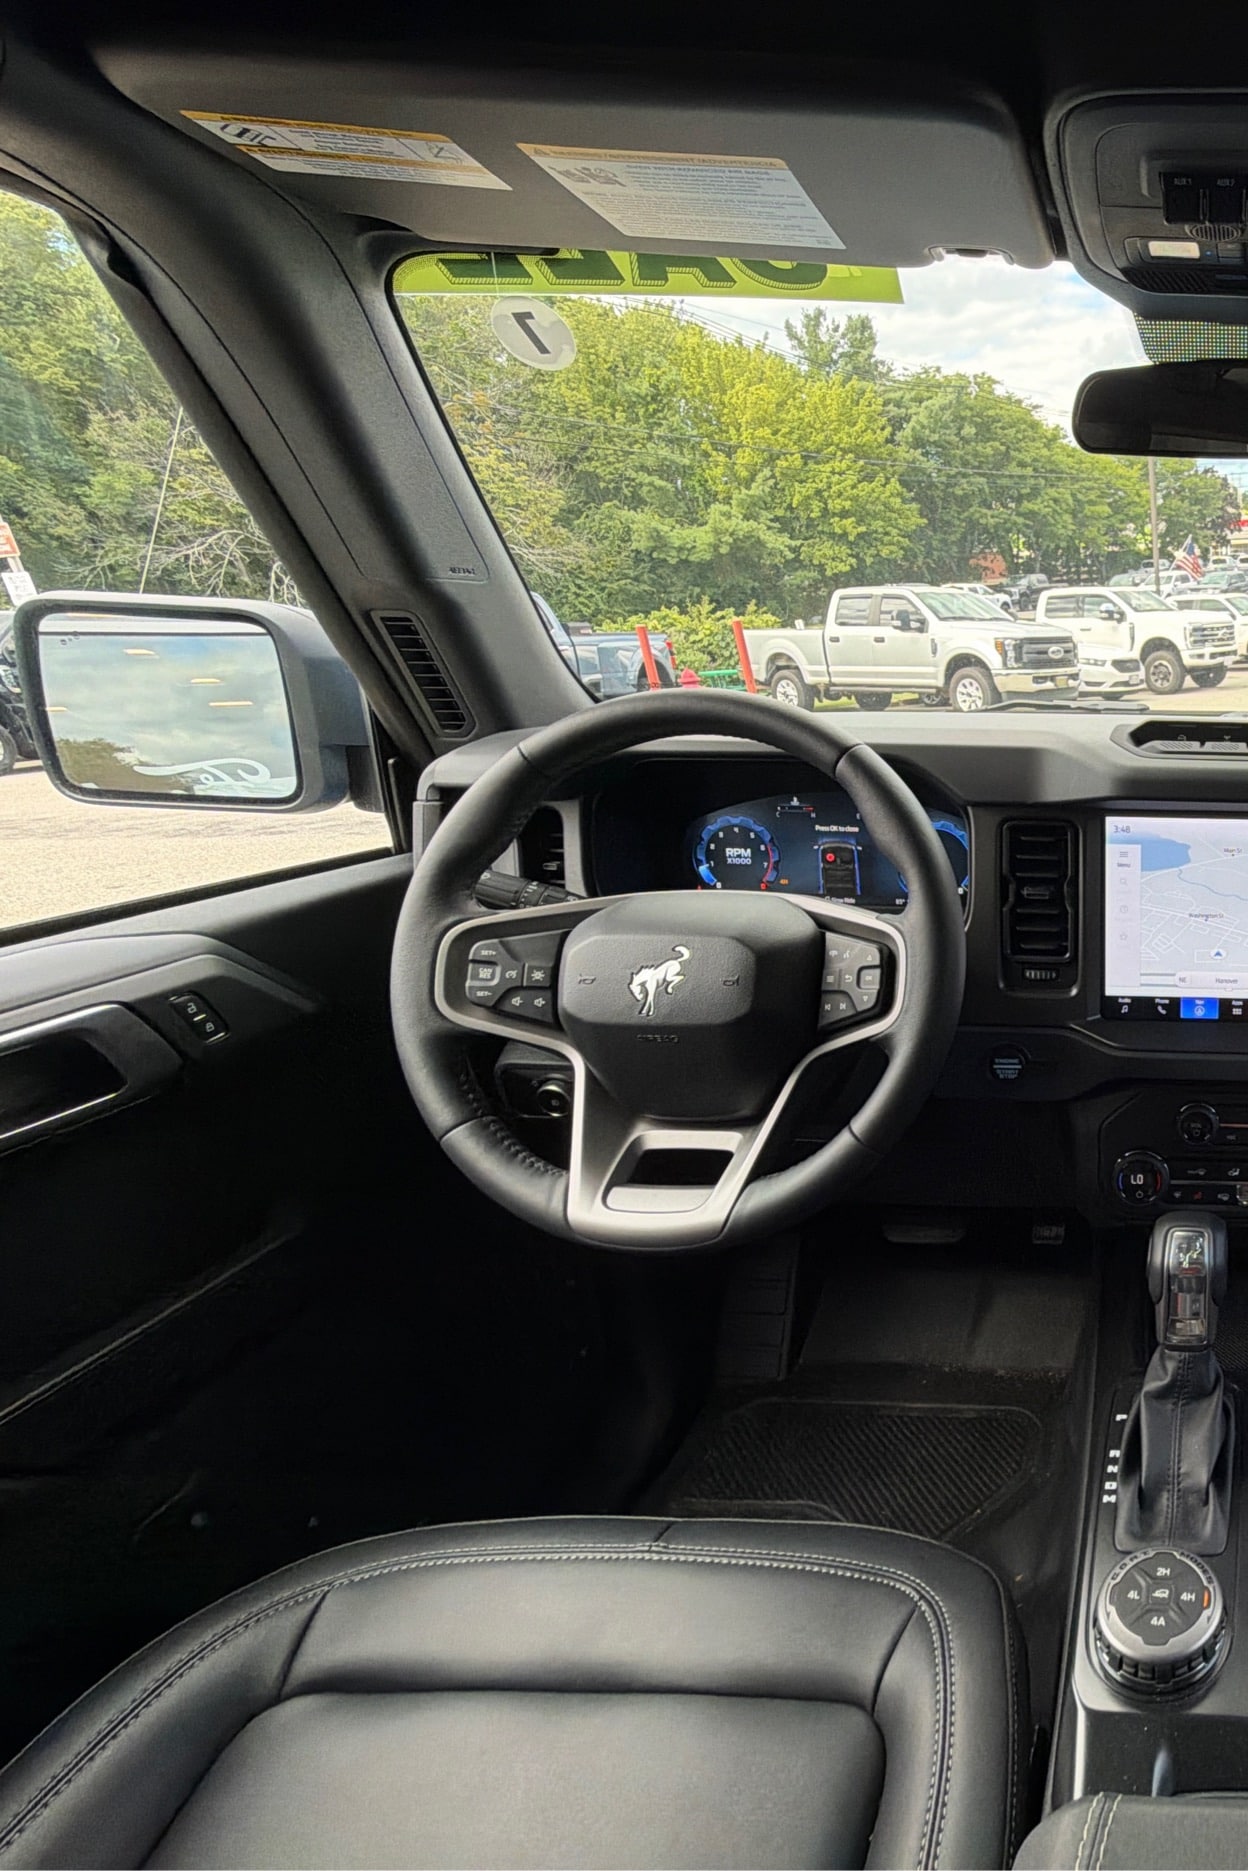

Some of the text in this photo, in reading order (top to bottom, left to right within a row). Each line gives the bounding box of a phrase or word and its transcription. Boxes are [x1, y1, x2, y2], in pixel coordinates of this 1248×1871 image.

[1113, 825, 1131, 833] 3:48
[725, 848, 751, 857] RPM
[1130, 1174, 1144, 1185] LO
[1107, 1465, 1118, 1473] N
[1102, 1495, 1116, 1503] M
[1156, 1567, 1171, 1576] 2H
[1127, 1590, 1140, 1600] 4L
[1180, 1592, 1195, 1602] 4H
[1150, 1616, 1165, 1626] 4A
